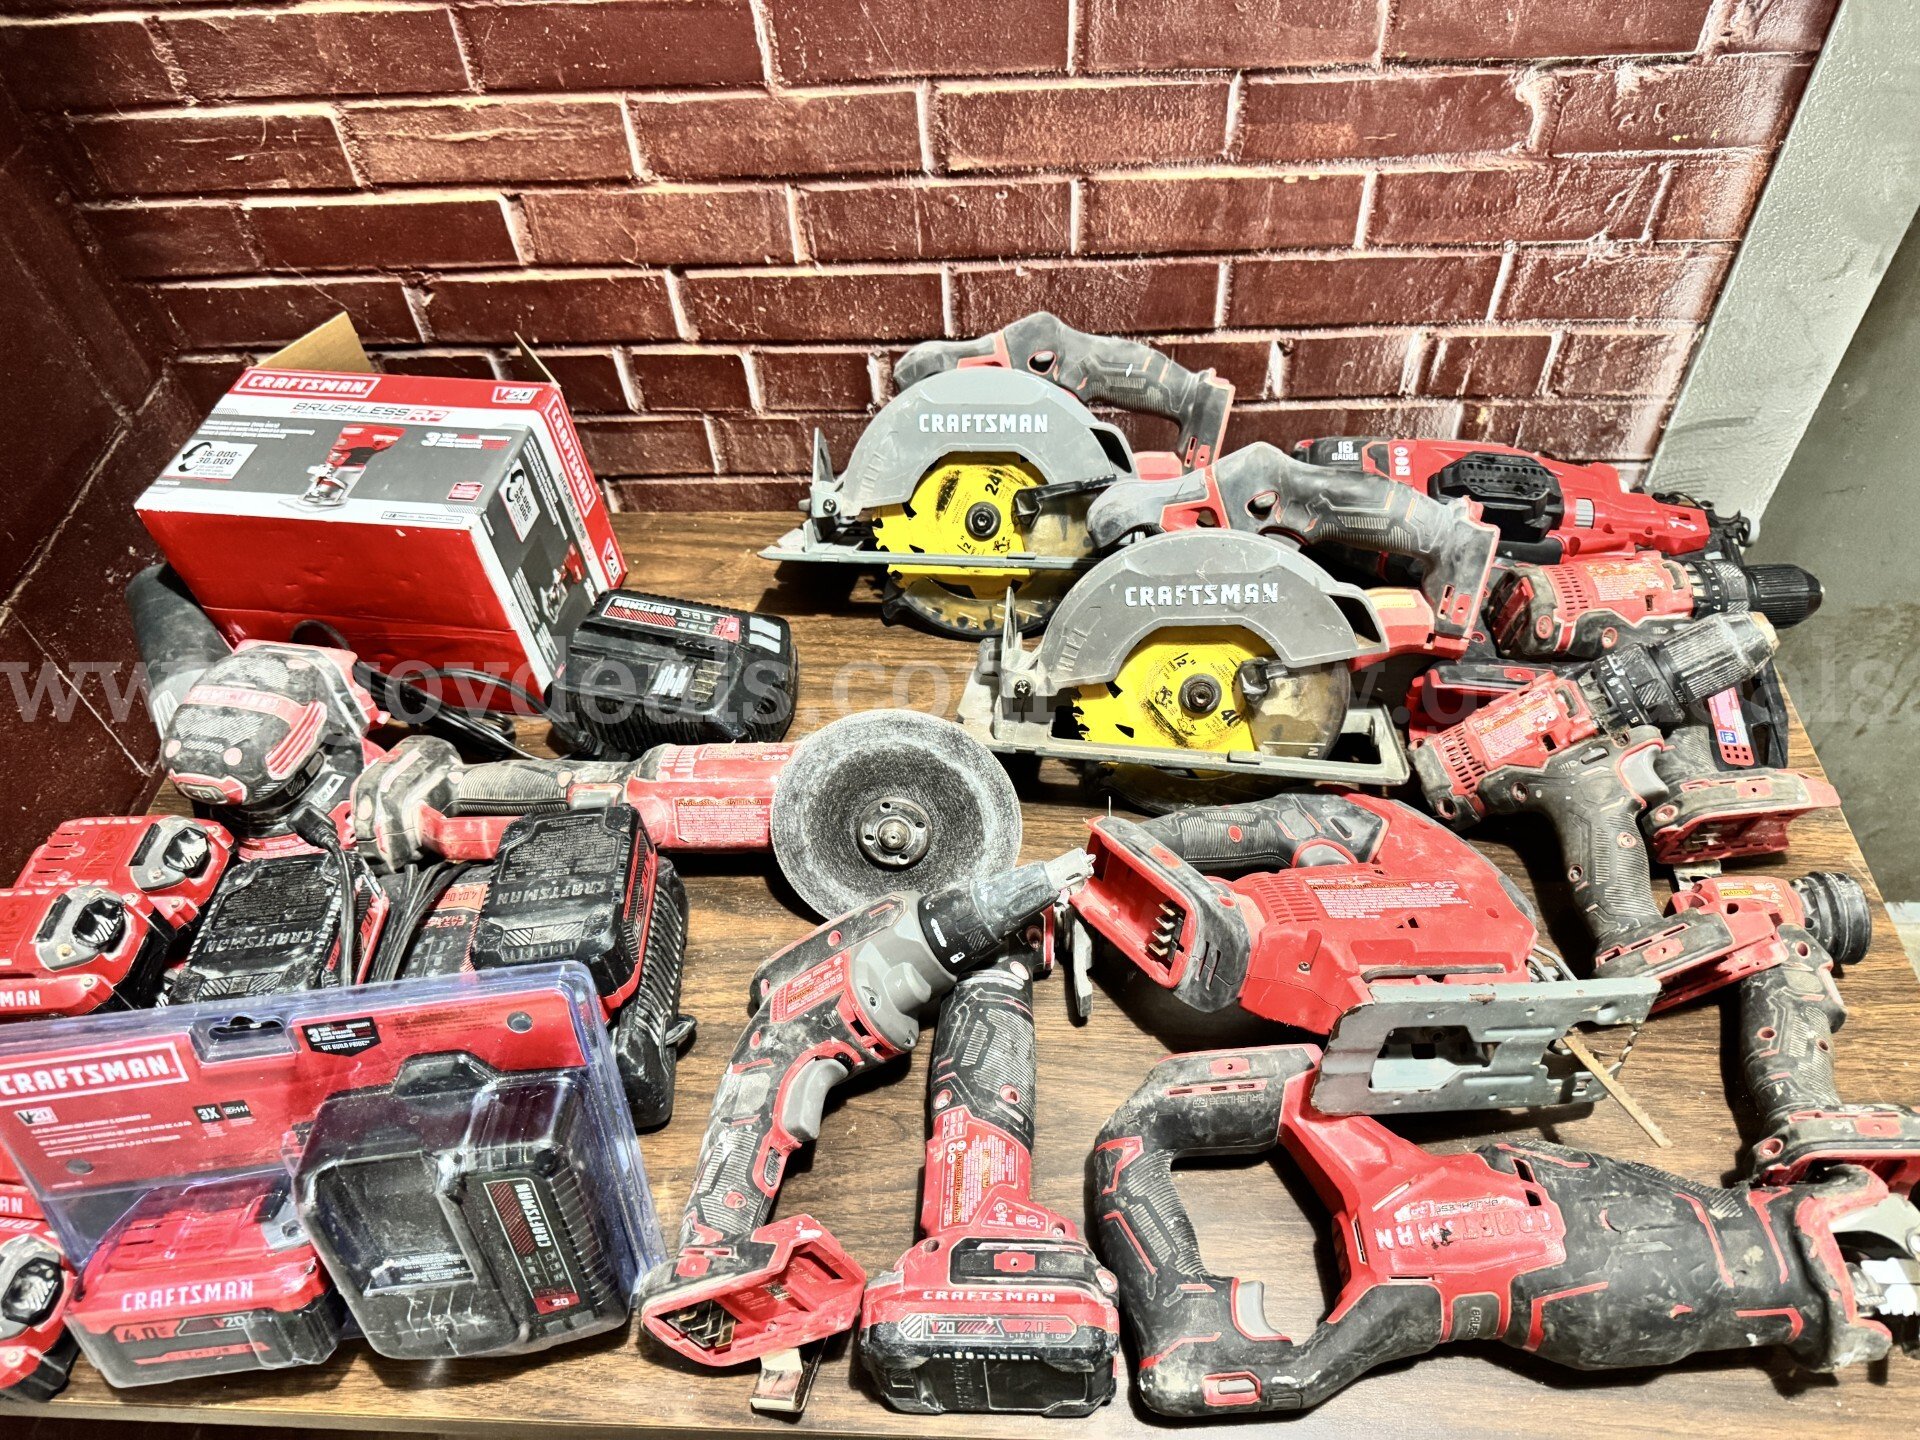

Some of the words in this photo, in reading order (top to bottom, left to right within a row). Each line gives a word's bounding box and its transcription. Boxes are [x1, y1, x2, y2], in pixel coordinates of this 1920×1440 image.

[247, 375, 368, 393] CRAFTSMAN
[293, 402, 409, 417] BRUSHLESS
[918, 413, 1049, 434] CRAFTSMAN
[550, 405, 592, 508] CRAFTSMAN
[1331, 452, 1359, 461] GAUGE
[984, 474, 1003, 496] 24
[1125, 582, 1279, 608] CRAFTSMAN
[613, 599, 677, 617] CRAFTSMAN
[496, 880, 606, 905] CRAFTSMAN
[203, 929, 314, 953] CRAFTSMAN
[307, 1028, 321, 1042] 3
[197, 1106, 221, 1121] 3X
[515, 1183, 551, 1248] CRAFTSMAN
[122, 1280, 253, 1313] CRAFTSMAN
[922, 1290, 1056, 1303] CRAFTSMAN
[212, 1316, 246, 1329] V20
[931, 1321, 956, 1334] V20
